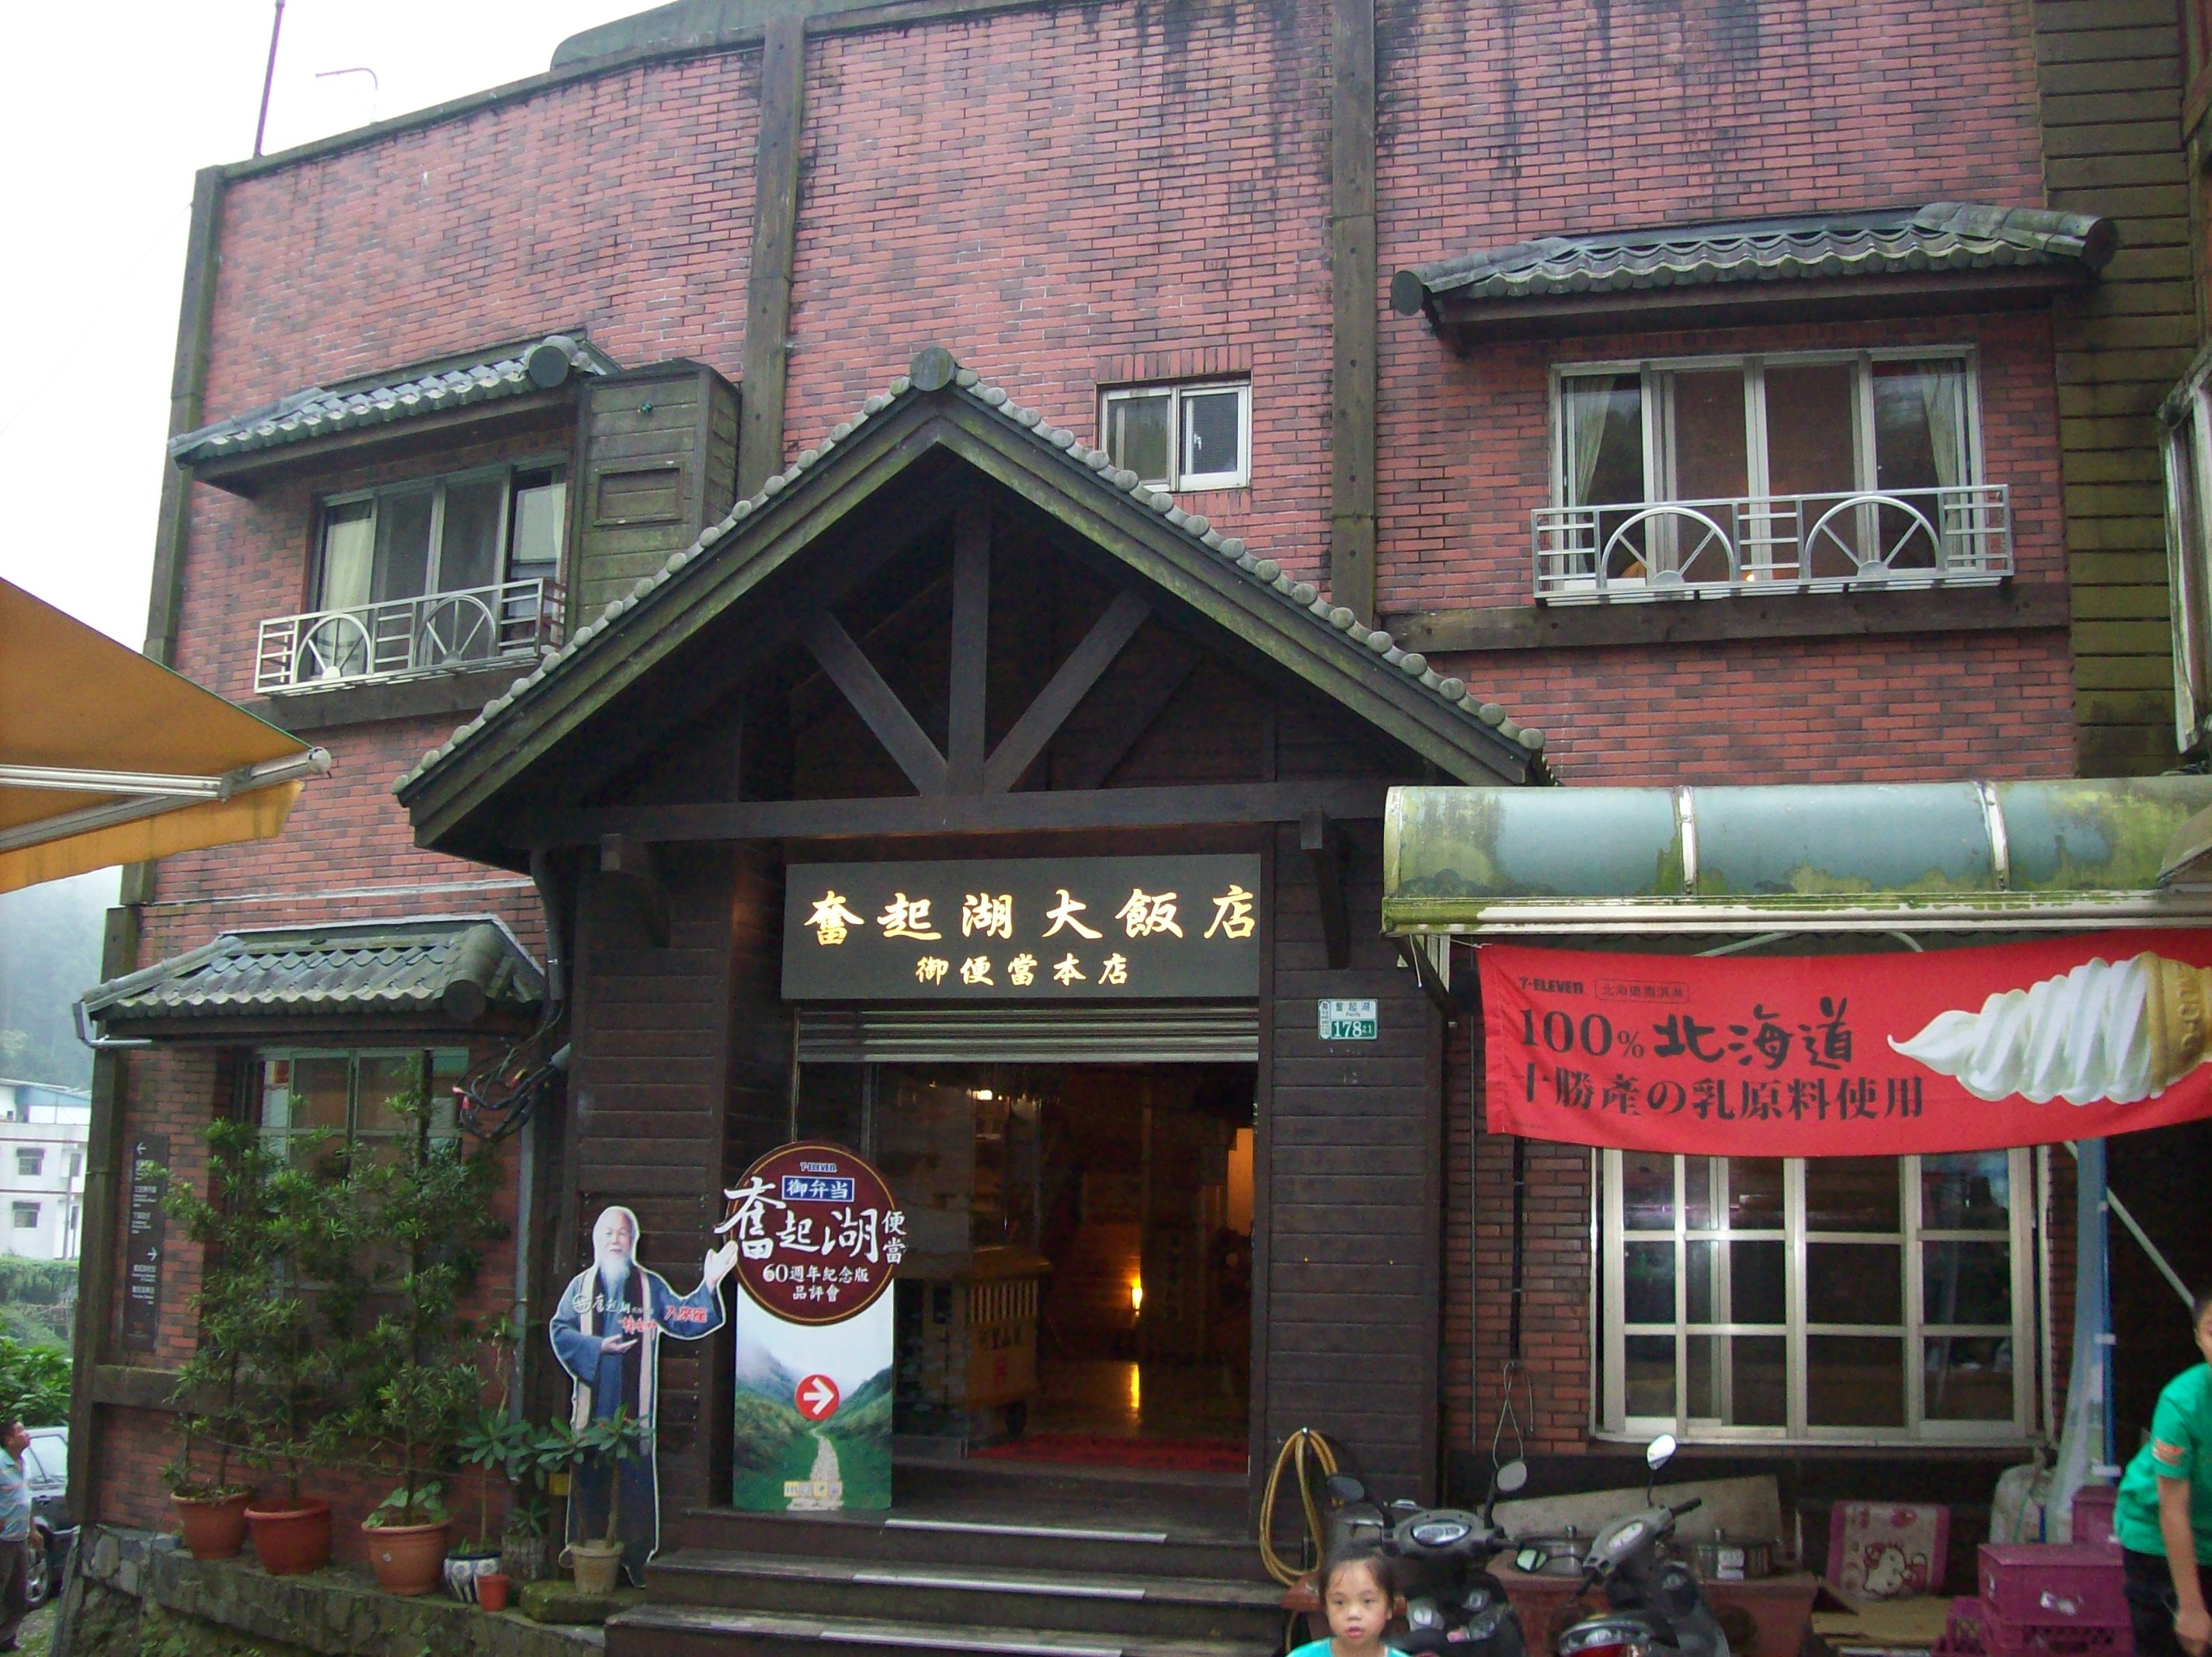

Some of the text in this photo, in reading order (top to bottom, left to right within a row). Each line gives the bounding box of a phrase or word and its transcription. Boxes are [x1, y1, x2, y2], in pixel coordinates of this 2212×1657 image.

[805, 884, 1256, 946] 奮起湖大飯店
[916, 953, 1129, 986] 御便當本店
[787, 1179, 849, 1200] 御弁当
[713, 1176, 880, 1264] 奮起湖
[882, 1210, 907, 1264] 便當
[762, 1263, 870, 1284] 60週年紀念版
[792, 1284, 840, 1303] 品評會
